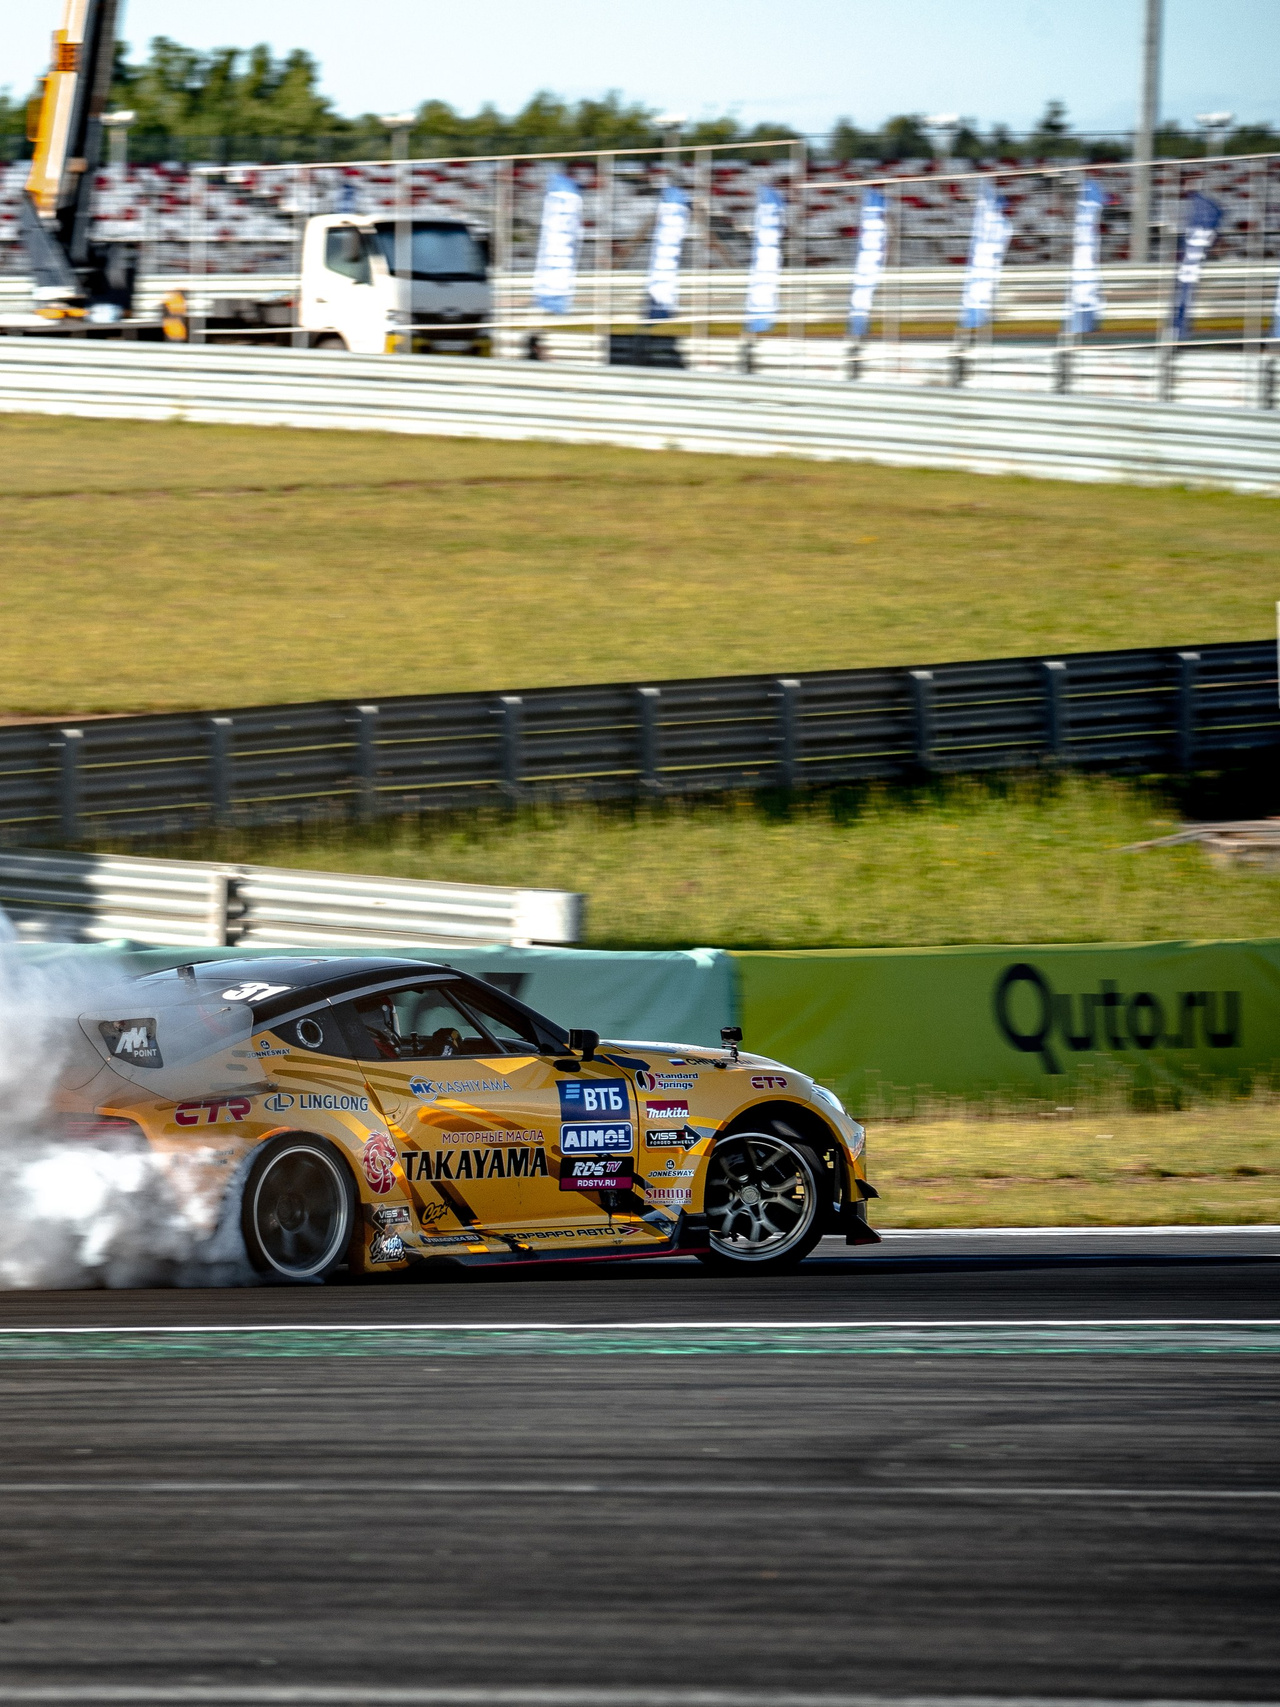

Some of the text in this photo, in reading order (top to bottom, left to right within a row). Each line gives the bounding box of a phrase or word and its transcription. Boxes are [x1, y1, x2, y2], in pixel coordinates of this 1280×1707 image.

[222, 982, 292, 1001] 31
[992, 963, 1241, 1074] Quto.ru
[134, 1049, 157, 1057] POINT
[436, 1078, 512, 1094] KASHIYAMA
[657, 1081, 694, 1090] Springs
[751, 1076, 787, 1089] CTR
[299, 1094, 368, 1112] LINGLONG
[583, 1088, 623, 1111] ВТБ
[175, 1097, 251, 1126] CTR
[442, 1130, 544, 1144] МОТОРНЫЕ МАСЛА
[564, 1130, 629, 1148] AIMOL
[401, 1147, 549, 1182] TAKAYAMA
[577, 1179, 616, 1187] RDSTV.RU
[645, 1189, 692, 1199] SIRUDA
[576, 1228, 616, 1236] АВТО
